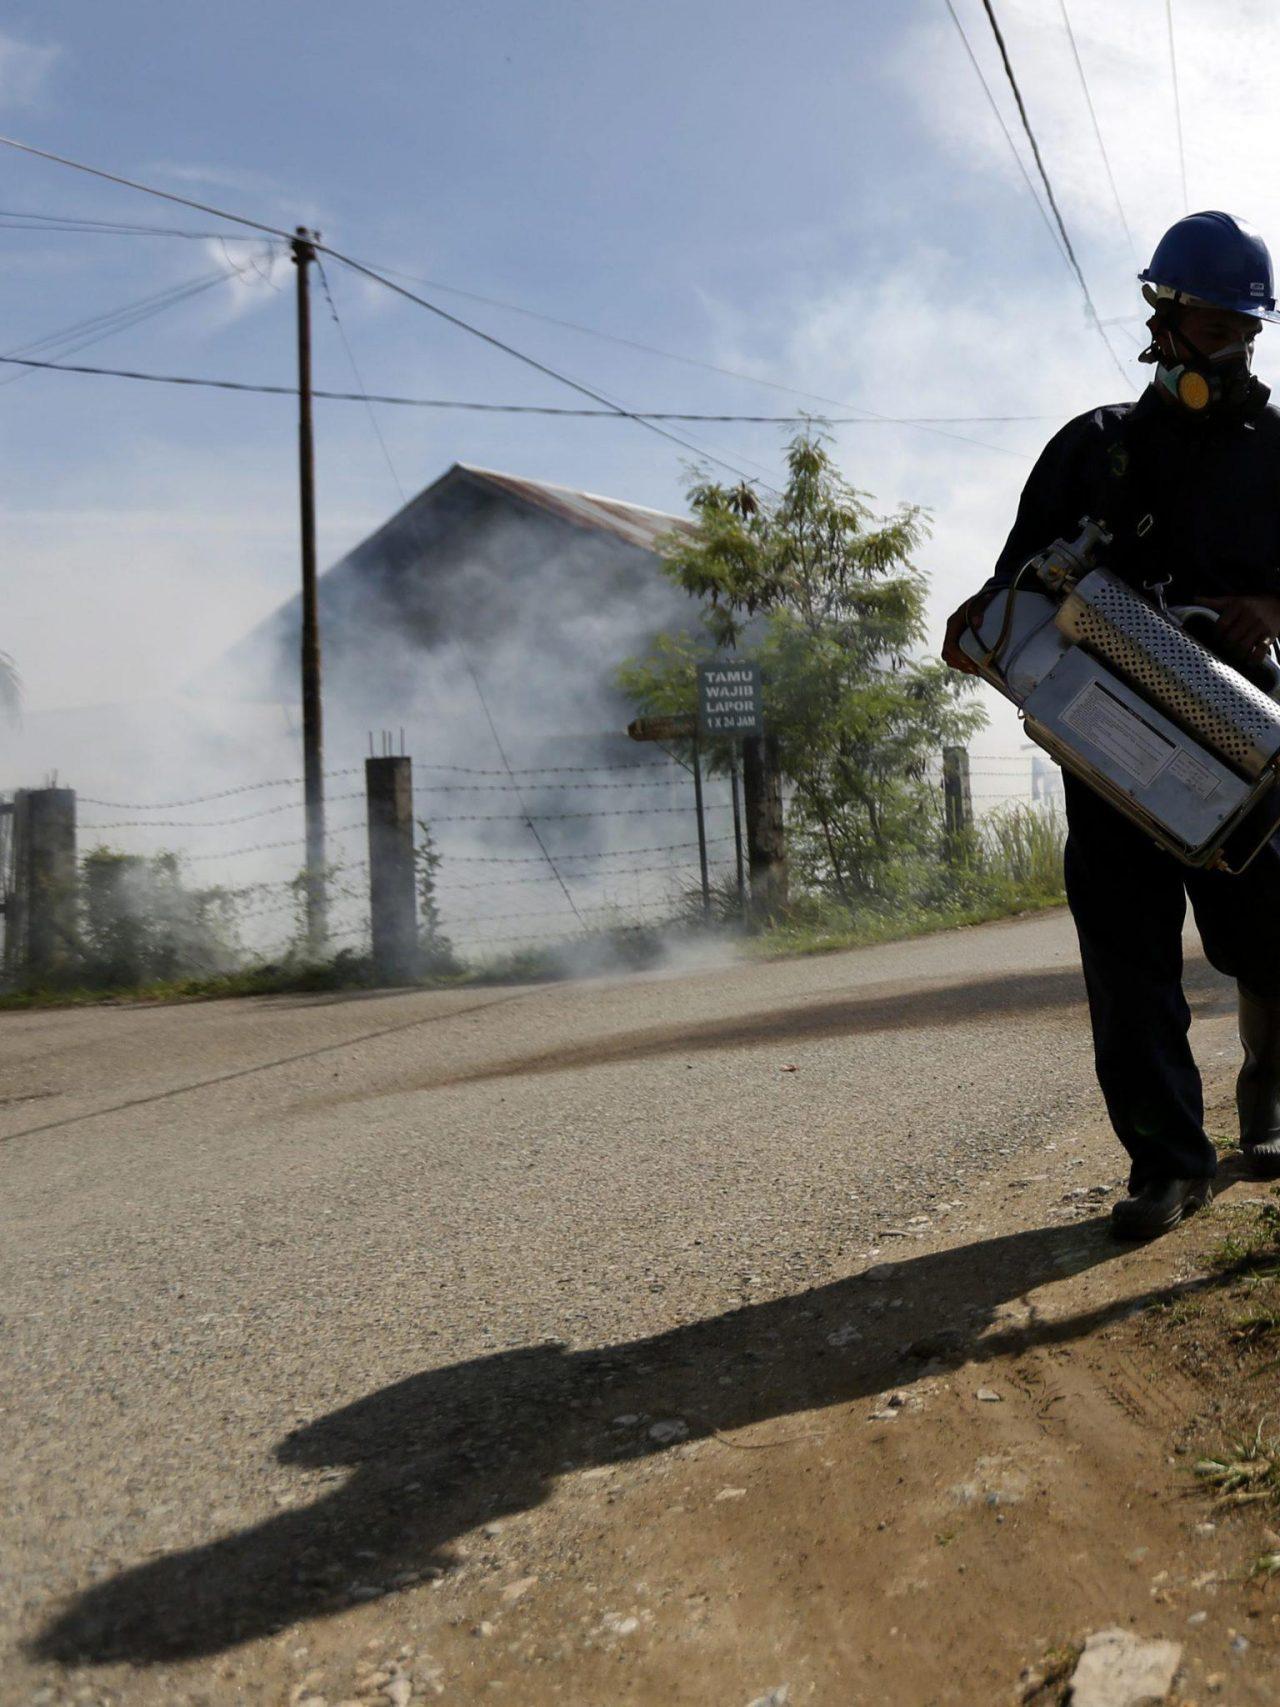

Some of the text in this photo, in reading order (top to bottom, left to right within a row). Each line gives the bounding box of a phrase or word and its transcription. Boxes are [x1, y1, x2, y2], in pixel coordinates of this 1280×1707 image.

[704, 671, 753, 683] TAMU
[705, 685, 754, 698] WAJIB
[706, 700, 754, 712] LAPOR
[707, 717, 713, 728] 1
